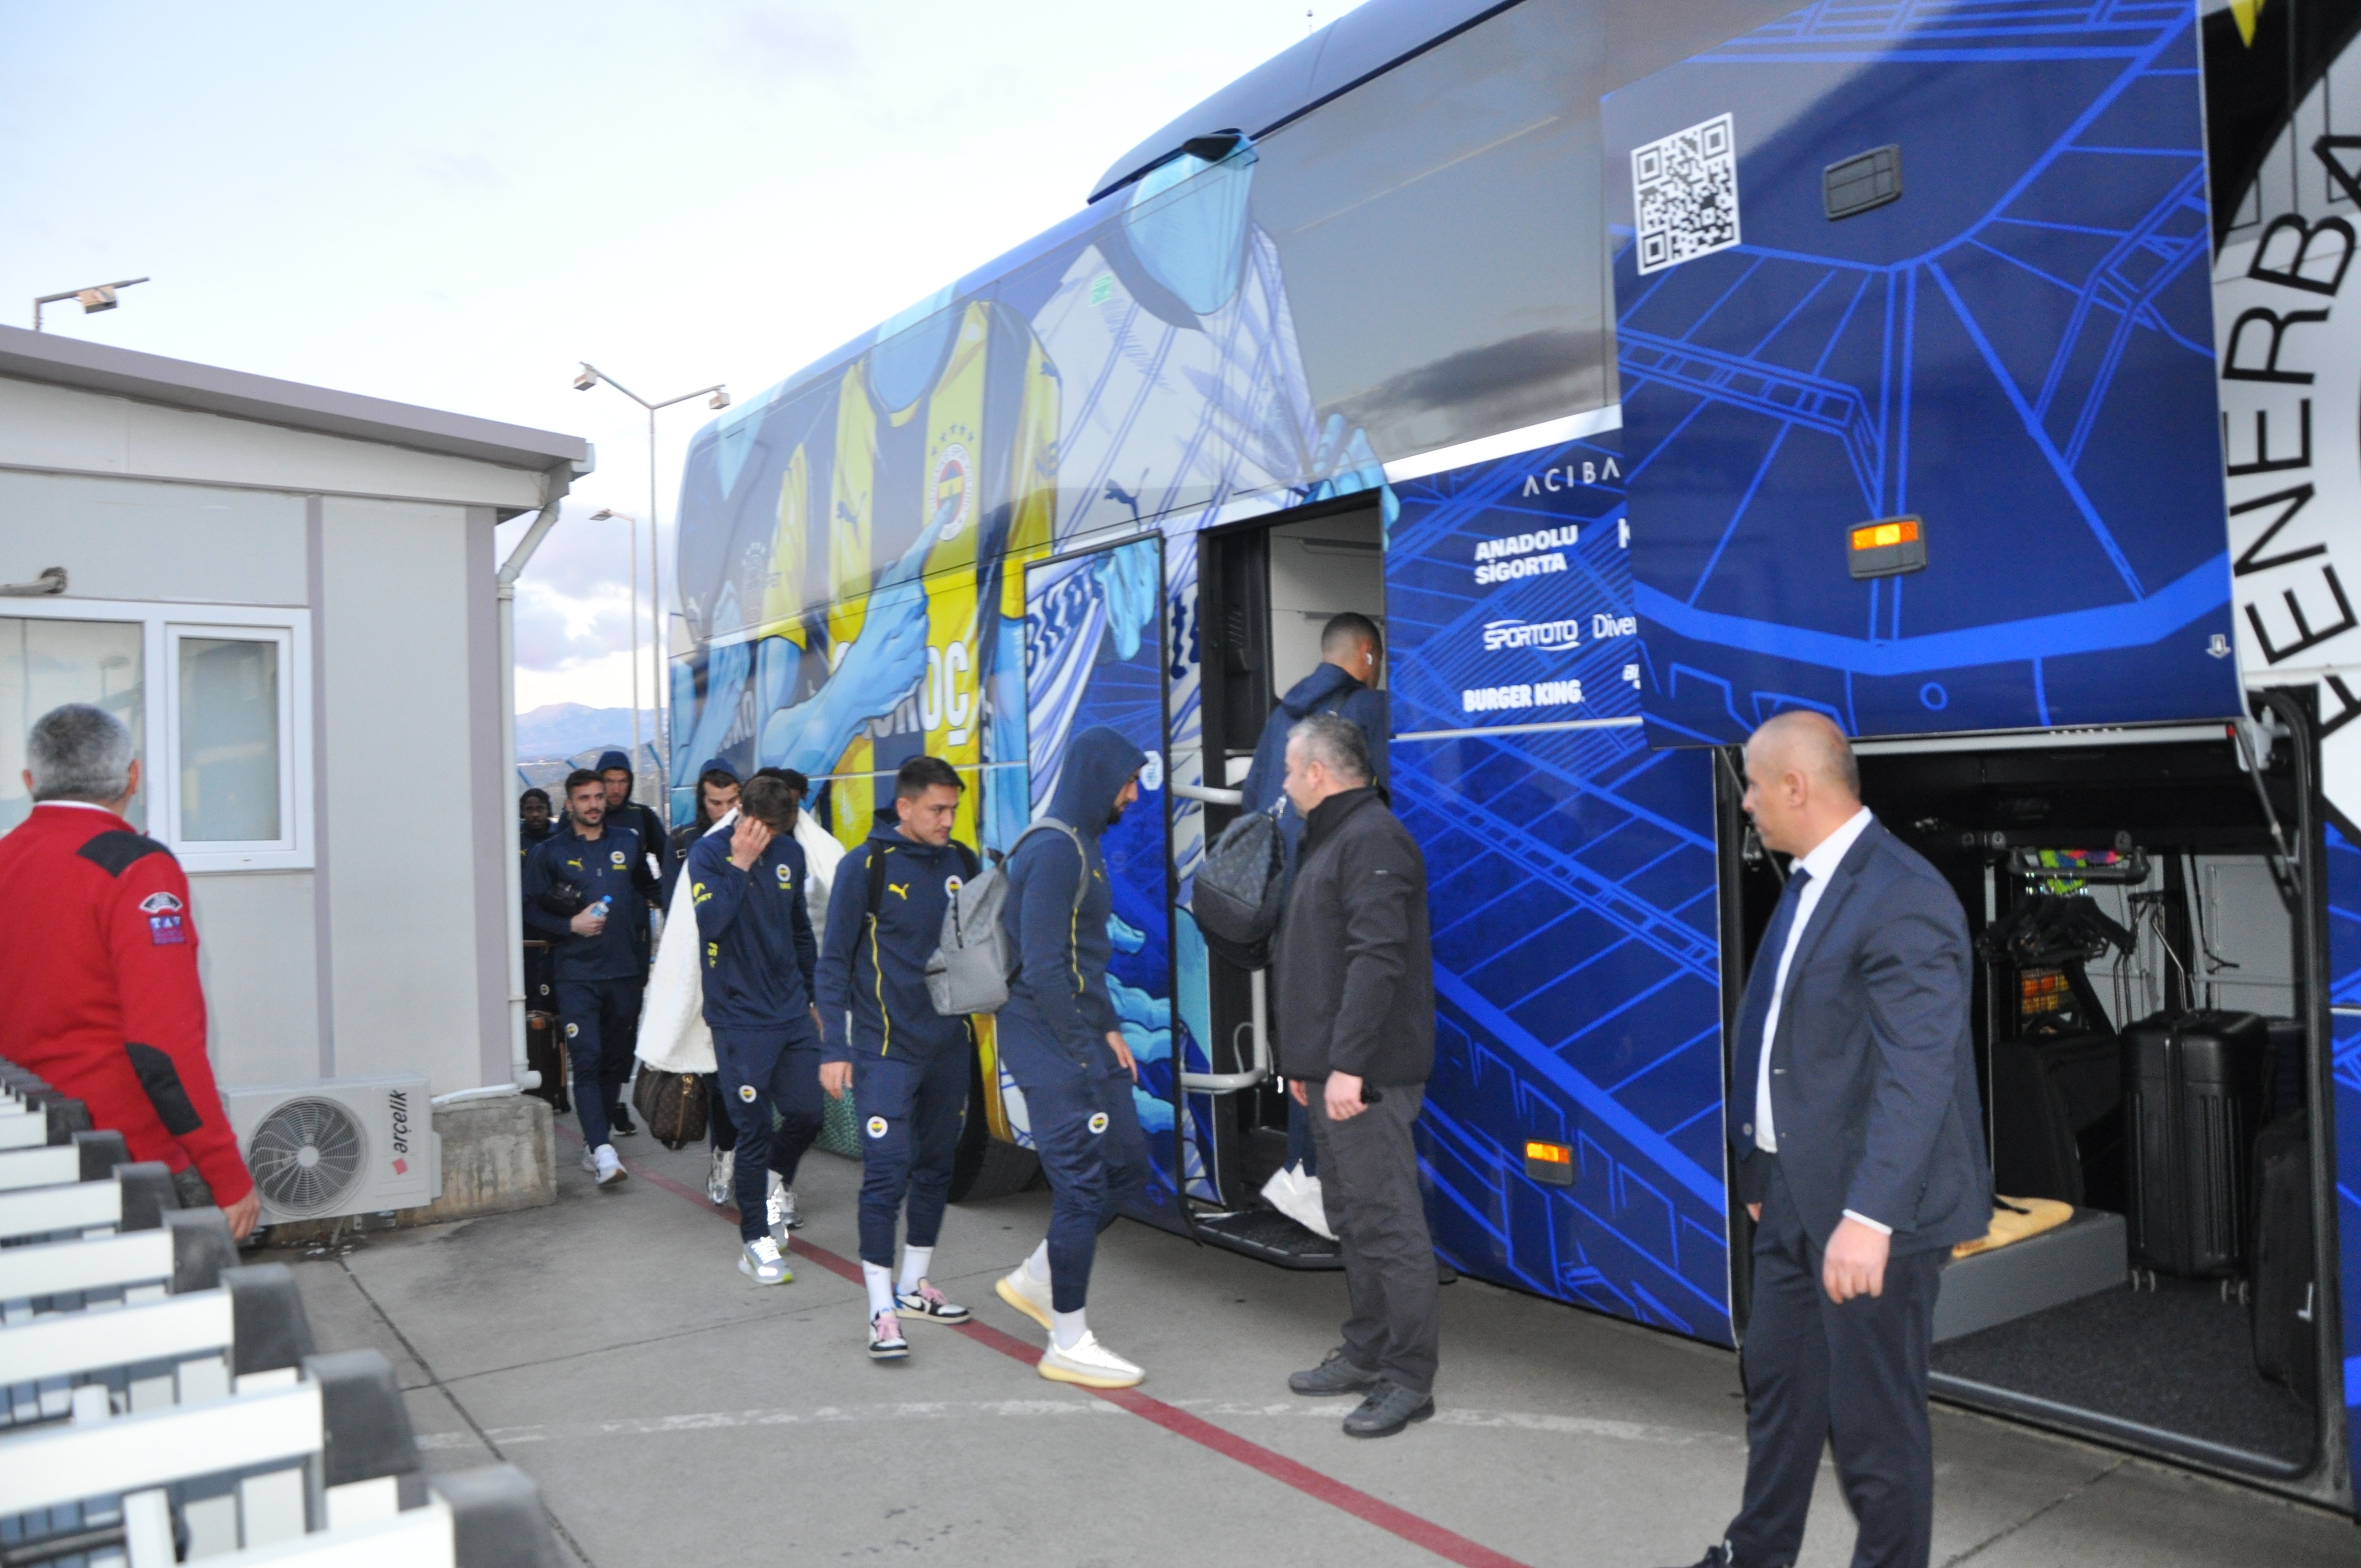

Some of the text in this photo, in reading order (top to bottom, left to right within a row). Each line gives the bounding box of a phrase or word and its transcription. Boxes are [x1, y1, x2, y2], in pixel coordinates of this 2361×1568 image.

[1522, 456, 1620, 497] ACIBA
[1475, 524, 1579, 562] ANADOLU
[1462, 679, 1582, 712] BURGER KING
[389, 1090, 412, 1153] arçelik
